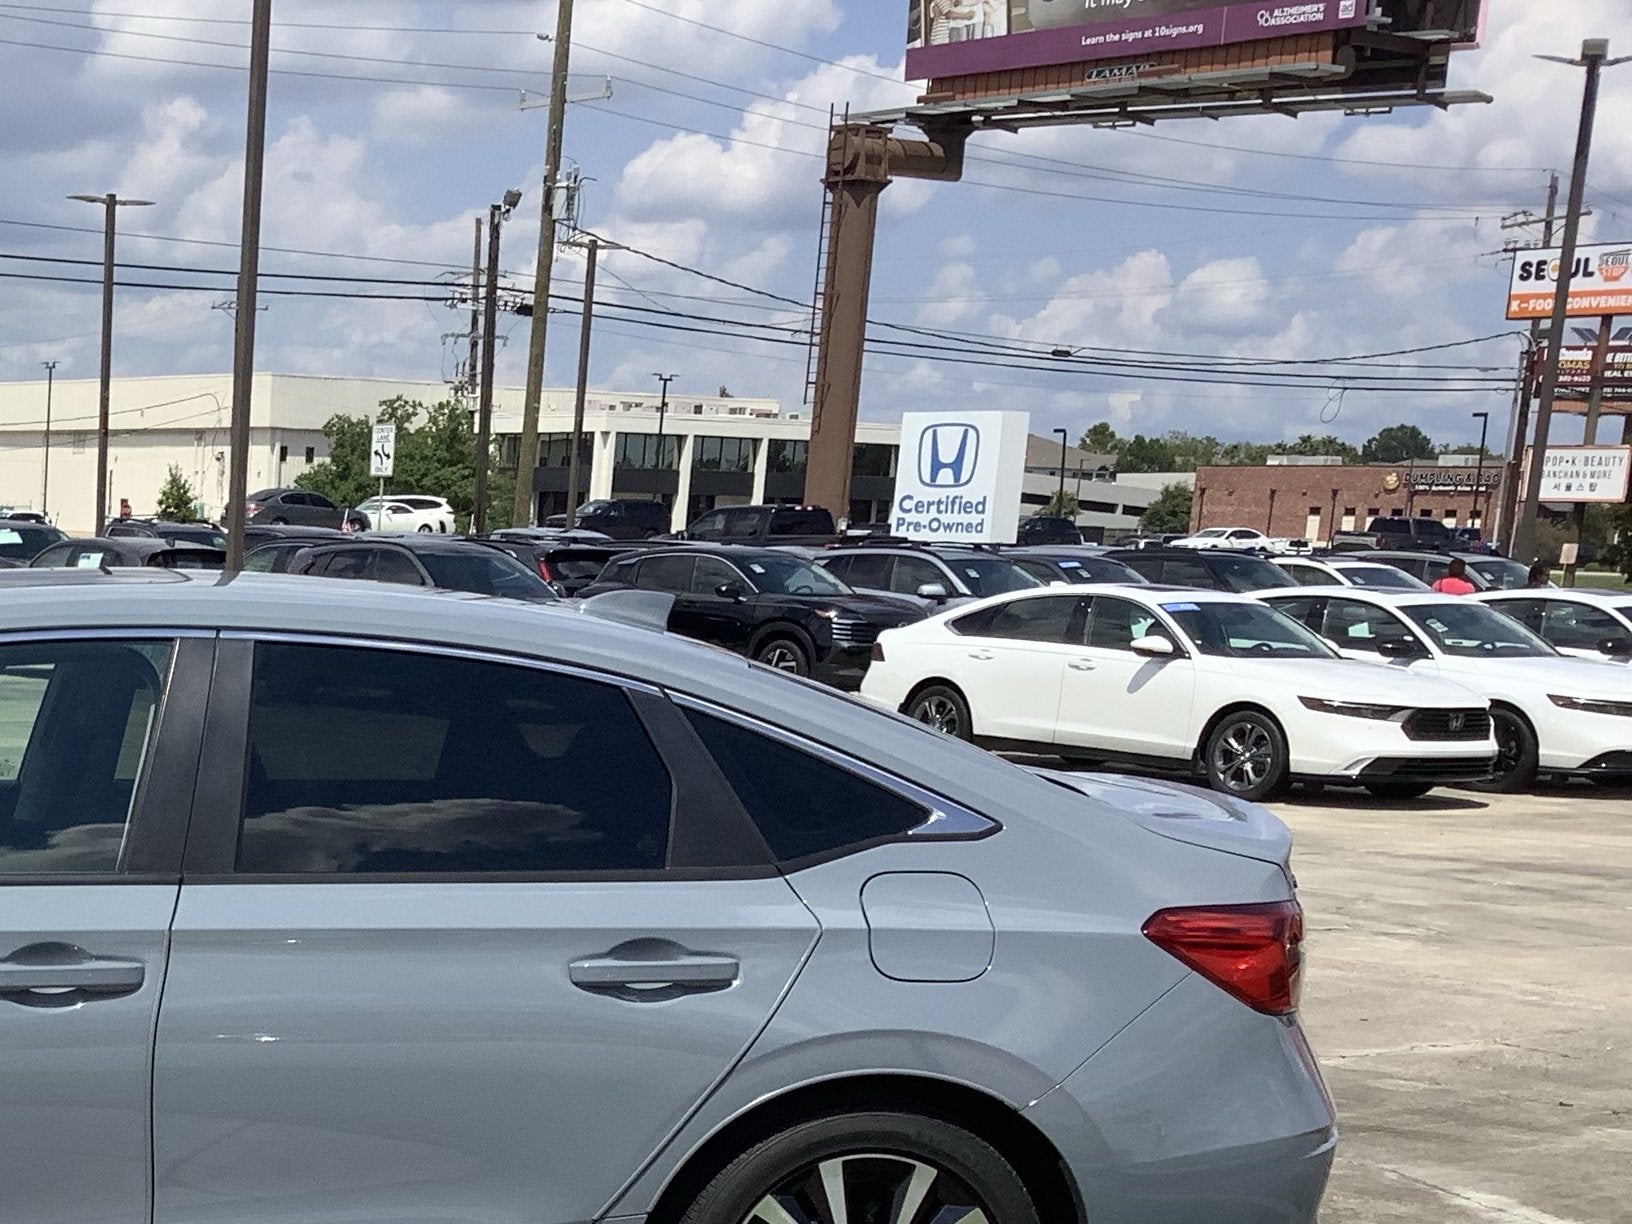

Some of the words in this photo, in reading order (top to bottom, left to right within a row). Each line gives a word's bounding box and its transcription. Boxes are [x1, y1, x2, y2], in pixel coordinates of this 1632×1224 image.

[1270, 12, 1324, 25] ASSOCIATION
[1081, 34, 1104, 45] Learn
[1106, 32, 1120, 42] the
[1121, 29, 1142, 42] signs
[1144, 29, 1153, 38] at
[1155, 23, 1204, 37] 10signs.org
[1511, 298, 1554, 311] K-FOO
[1404, 472, 1462, 484] DUMPLING
[898, 494, 987, 514] Certified
[895, 517, 985, 533] Pre-Owned
